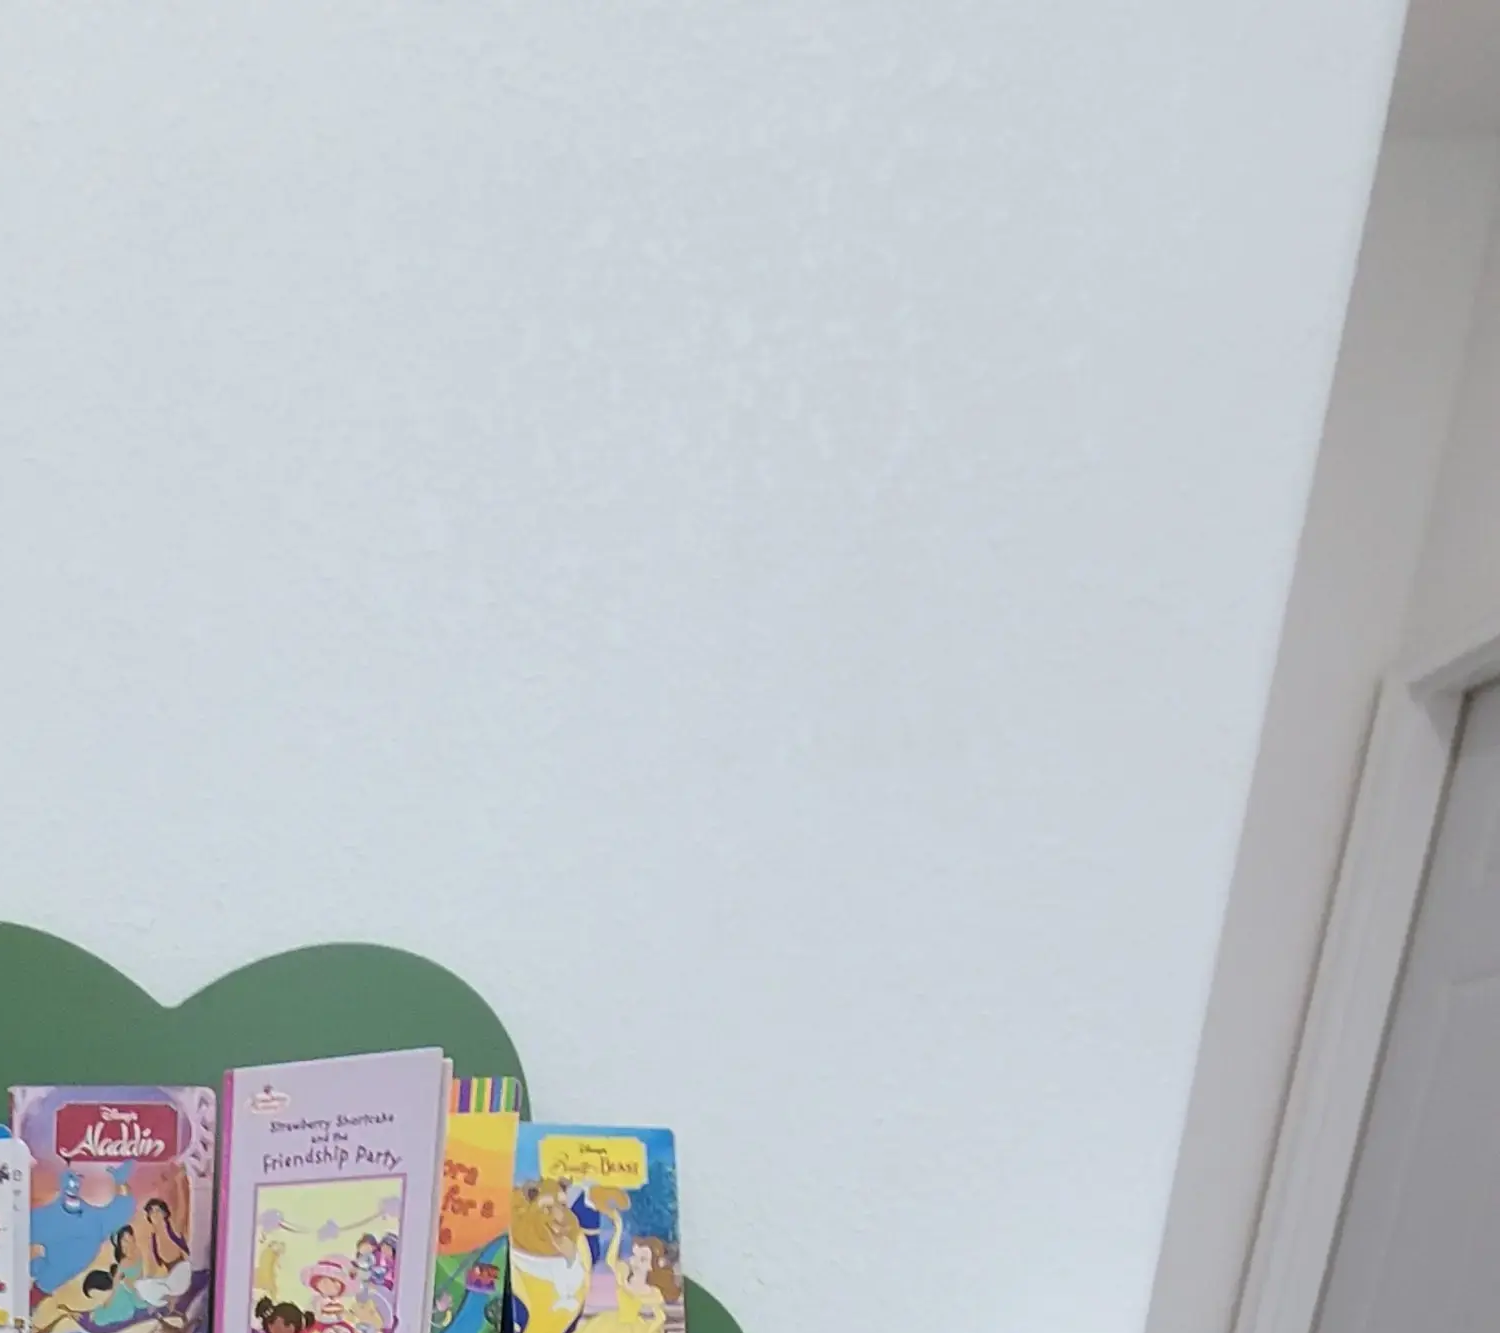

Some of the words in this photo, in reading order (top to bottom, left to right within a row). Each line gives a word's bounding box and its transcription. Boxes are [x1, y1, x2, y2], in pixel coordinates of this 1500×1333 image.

[59, 1121, 166, 1157] Aladdin
[311, 1132, 329, 1144] and
[333, 1132, 349, 1142] the
[263, 1145, 350, 1175] Friendship
[355, 1145, 402, 1171] Party
